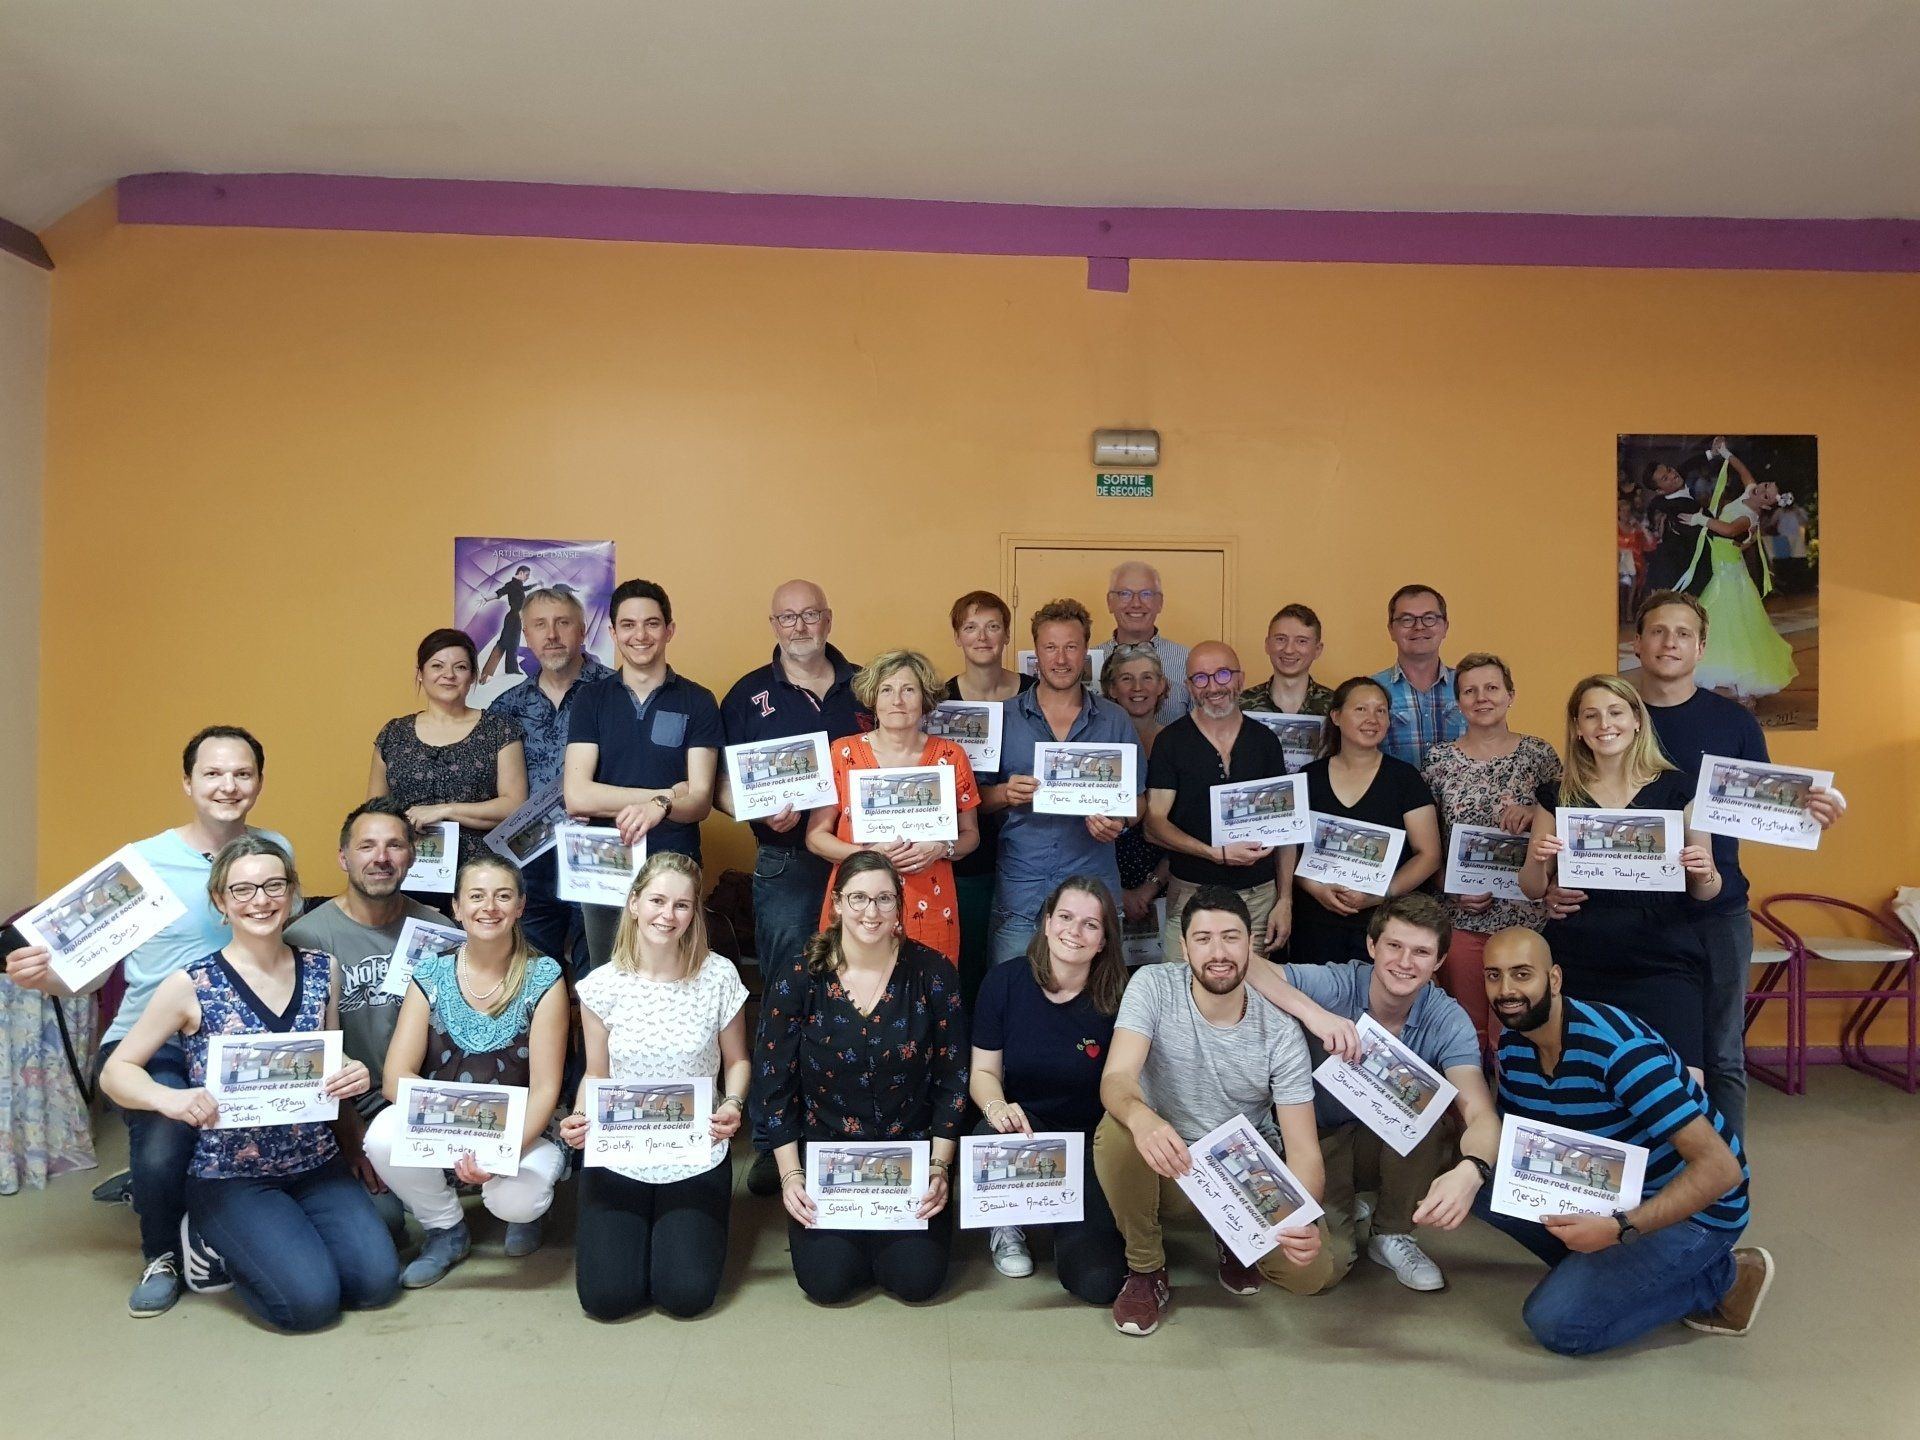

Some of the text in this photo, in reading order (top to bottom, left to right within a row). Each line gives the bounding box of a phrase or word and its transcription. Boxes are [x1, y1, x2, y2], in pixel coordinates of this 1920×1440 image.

[1104, 475, 1145, 485] SORTIE
[1096, 486, 1152, 496] DE SECOURS
[752, 690, 775, 717] 7
[1573, 851, 1603, 860] Diplôme
[94, 920, 110, 935] rock
[224, 1085, 256, 1093] Diplôme
[1371, 1080, 1387, 1098] rock
[411, 1125, 442, 1134] Diplôme
[1205, 1155, 1227, 1183] Diplôme
[1226, 1181, 1242, 1198] rock
[1239, 1196, 1248, 1204] et
[1515, 1171, 1548, 1184] Diplôme
[1550, 1179, 1570, 1190] rock
[1572, 1185, 1581, 1194] et
[822, 1187, 852, 1195] Diplôme
[977, 1184, 1005, 1192] Diplôme
